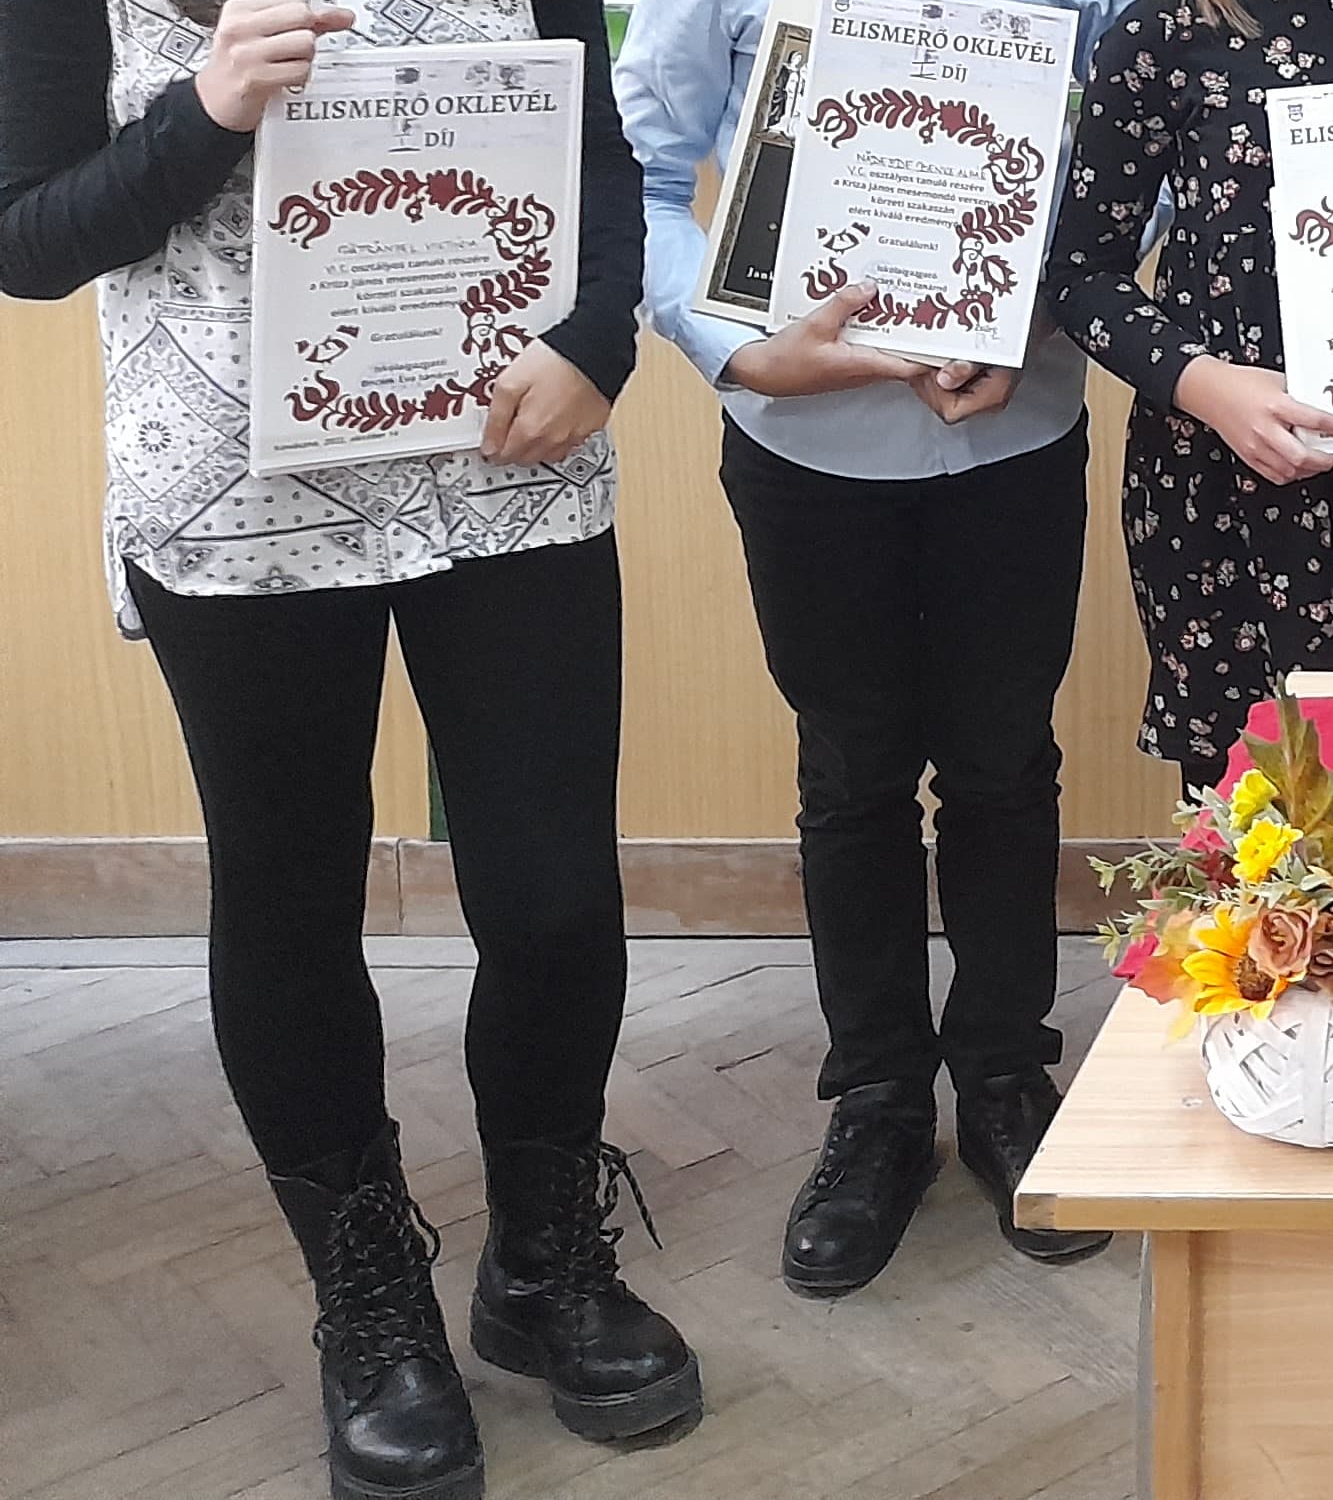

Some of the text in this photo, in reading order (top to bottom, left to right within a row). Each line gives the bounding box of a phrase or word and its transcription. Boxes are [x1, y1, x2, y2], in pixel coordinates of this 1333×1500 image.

[830, 16, 1057, 66] ELISMERŐ OKLEVÉL
[940, 61, 968, 83] DÍJ
[434, 88, 557, 117] OKLEVÉL
[423, 128, 455, 148] DÍJ
